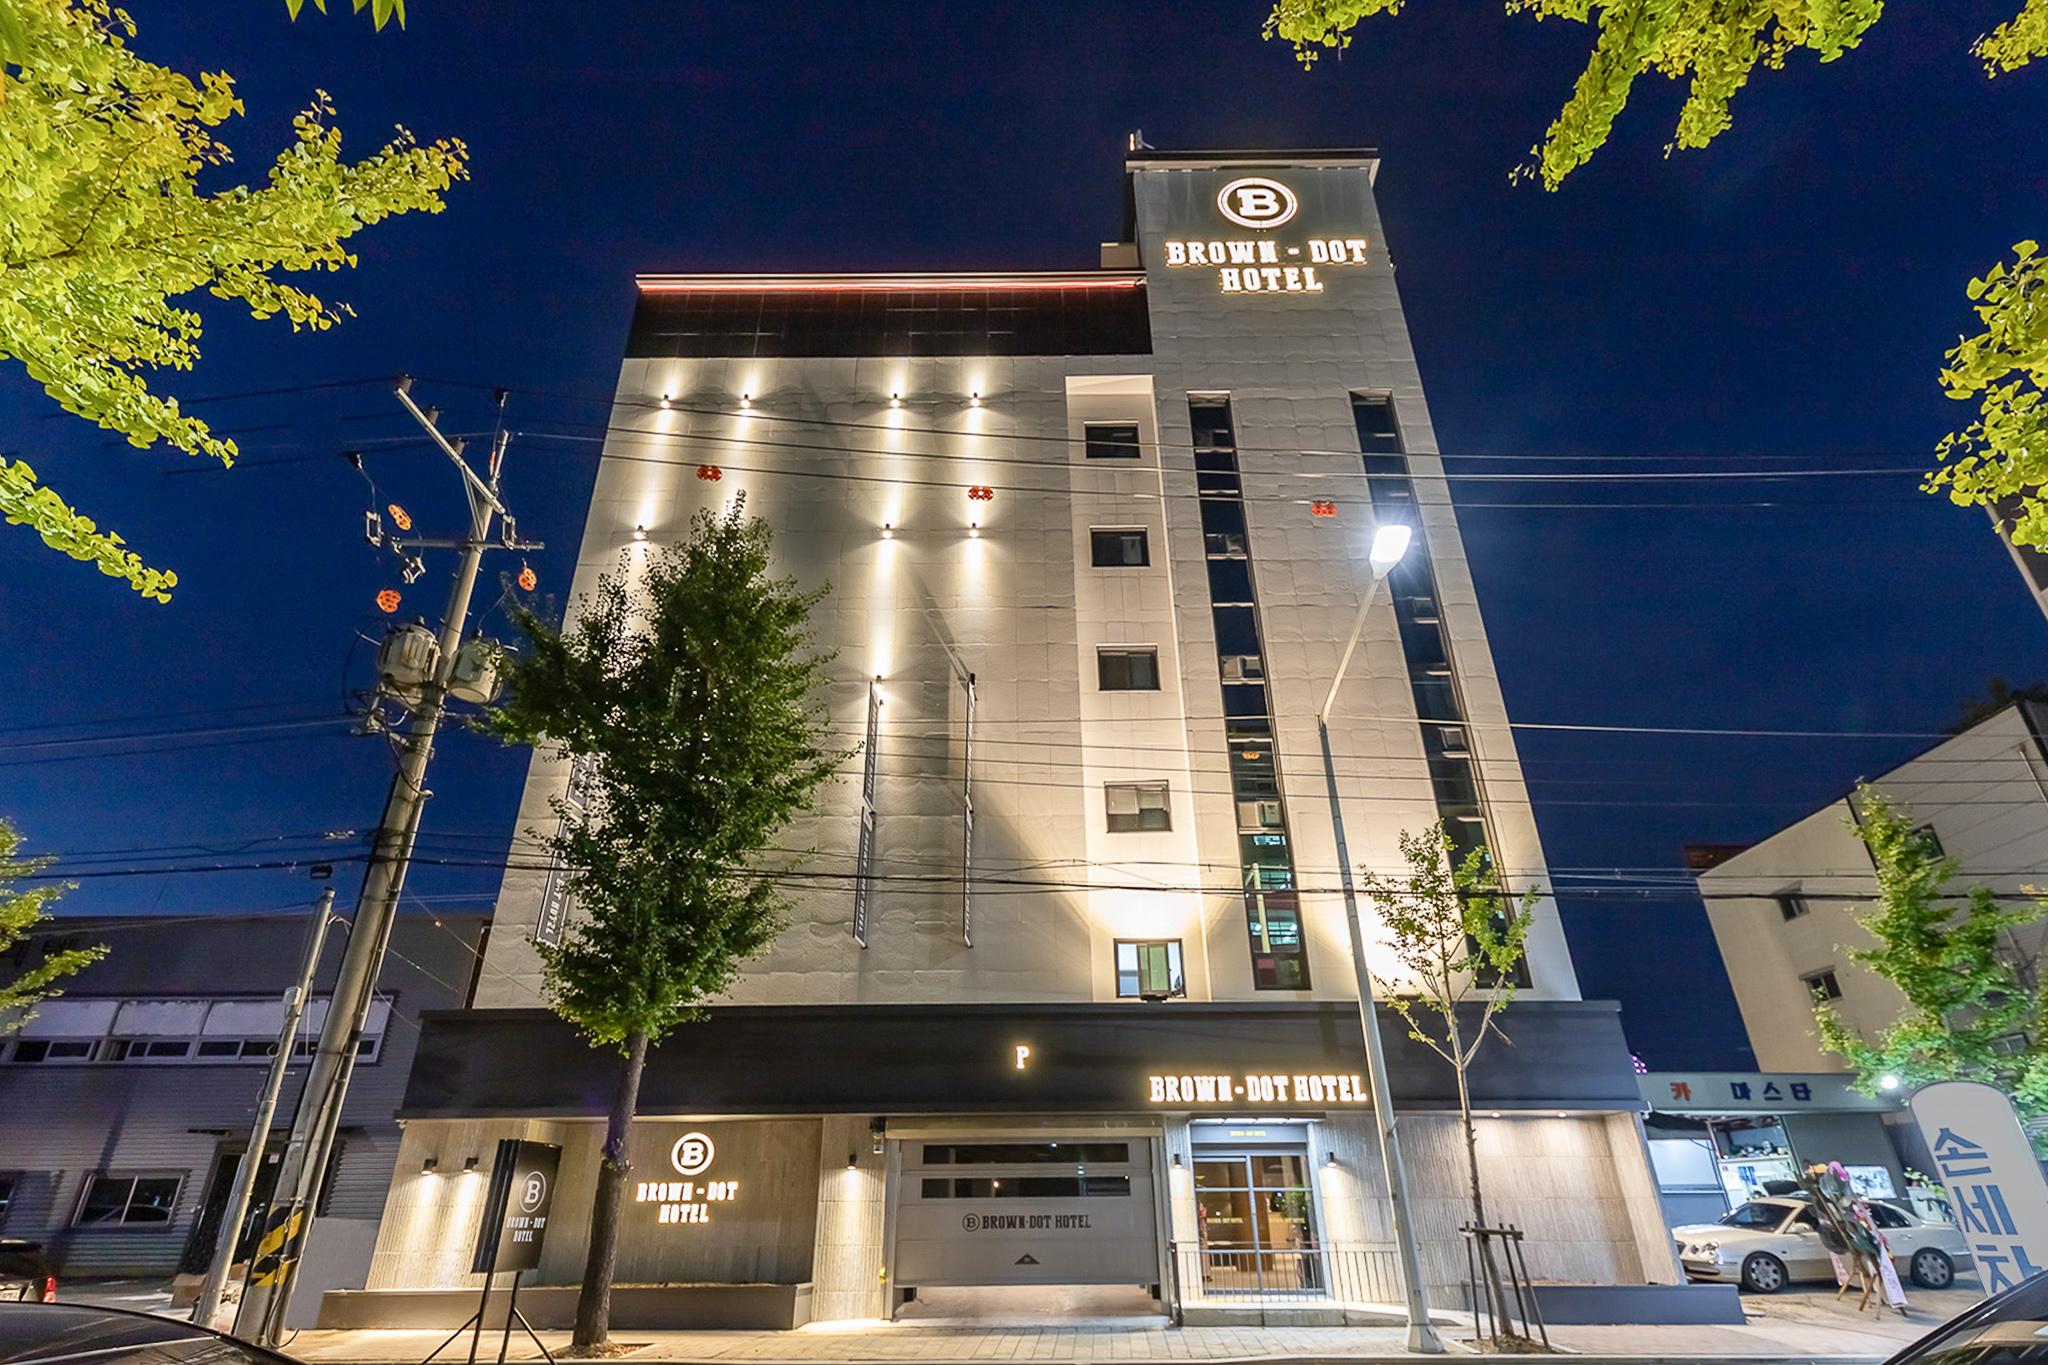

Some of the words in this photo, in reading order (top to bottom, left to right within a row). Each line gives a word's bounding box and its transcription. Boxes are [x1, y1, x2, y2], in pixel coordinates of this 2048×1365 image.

[1165, 240, 1279, 265] BROWN
[1308, 239, 1367, 263] DOT
[1219, 266, 1324, 292] HOTEL
[1015, 1045, 1031, 1070] P
[1293, 1075, 1367, 1102] HOTEL
[658, 1203, 710, 1224] HOTEL
[1055, 1214, 1092, 1229] HOTEL
